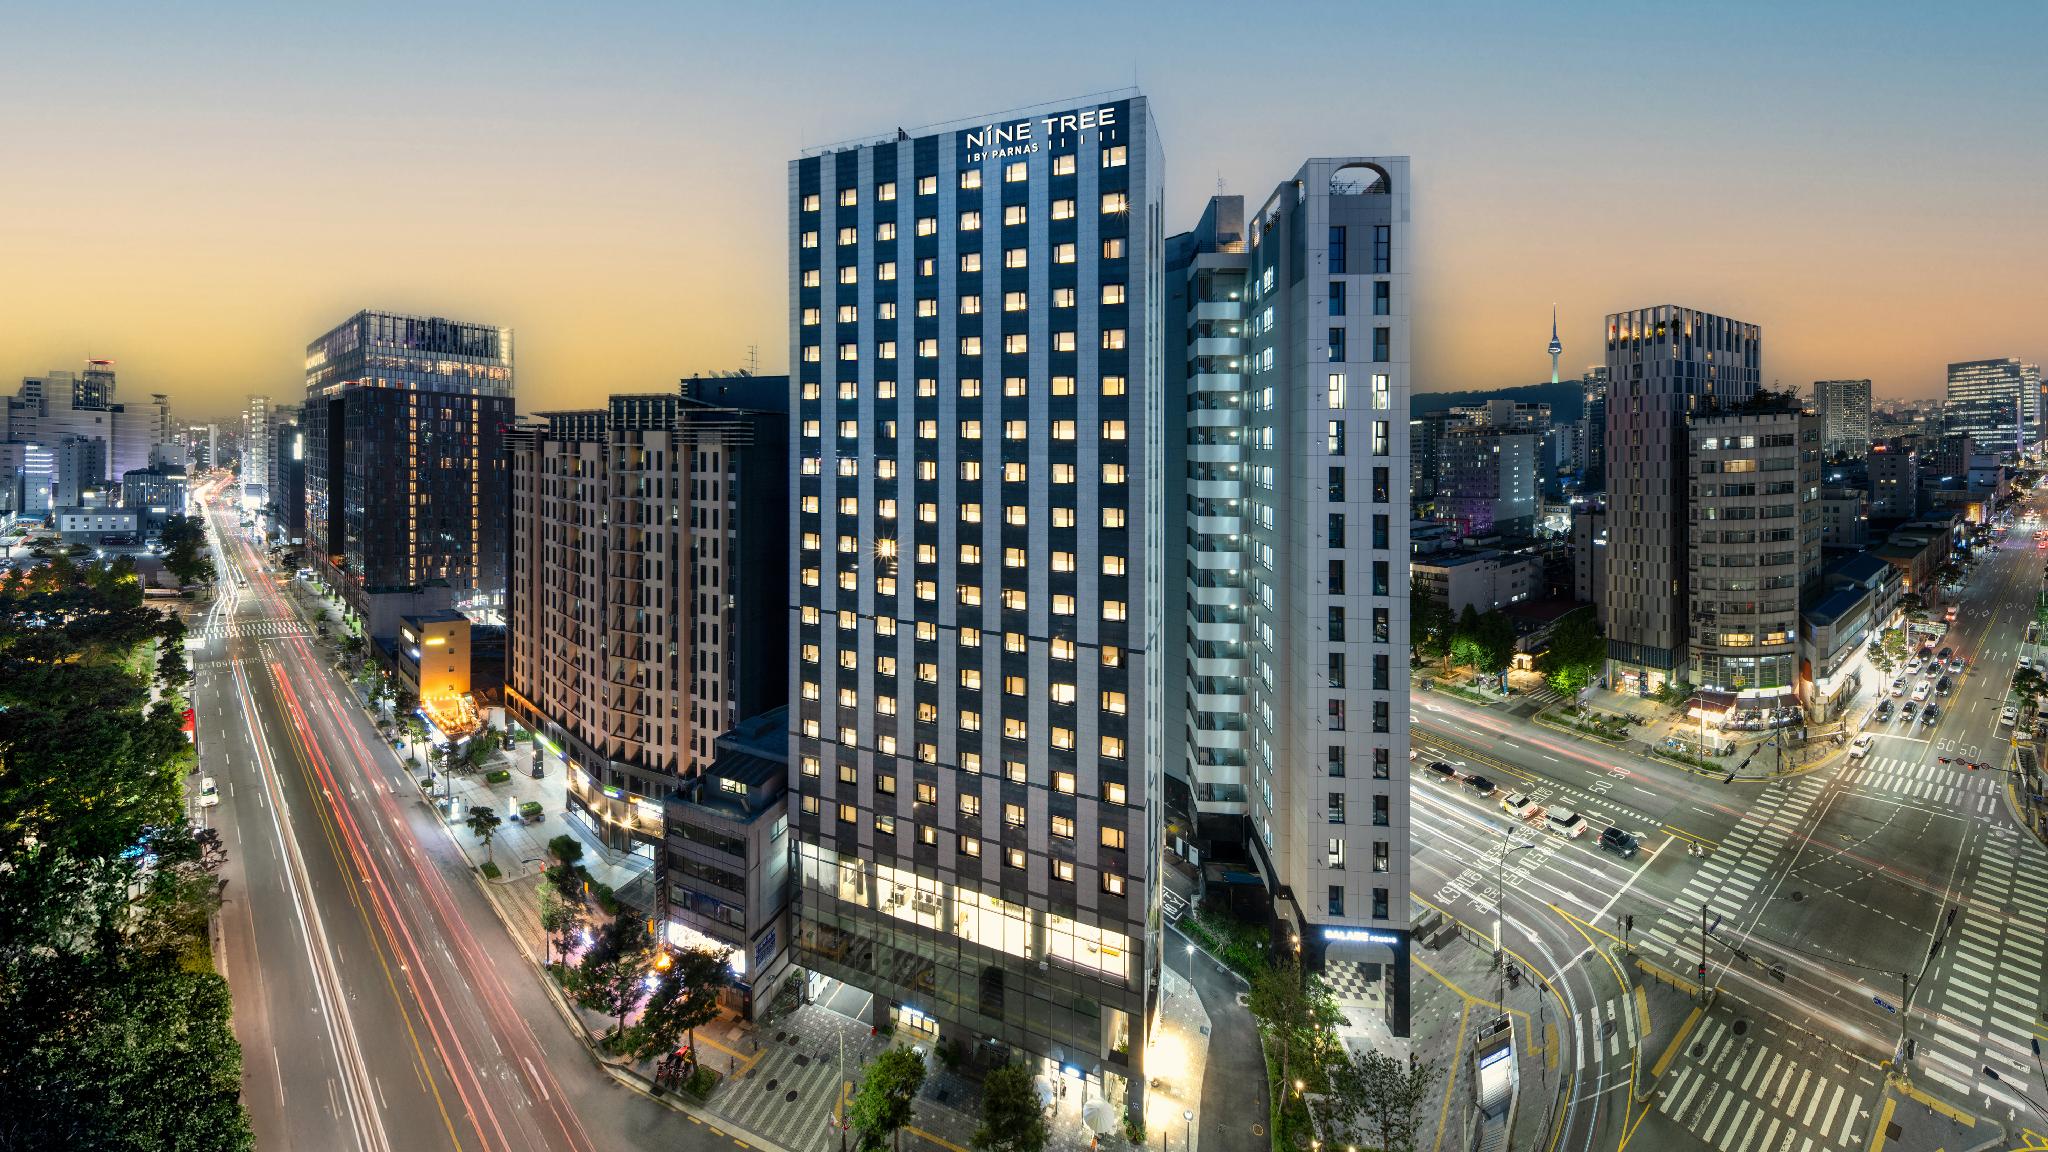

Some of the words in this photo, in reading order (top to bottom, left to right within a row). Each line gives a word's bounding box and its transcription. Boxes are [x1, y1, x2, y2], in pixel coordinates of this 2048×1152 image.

[1041, 107, 1116, 136] TREE
[991, 142, 1040, 160] PARNAS
[1937, 737, 1955, 752] 50
[1959, 743, 1978, 758] 50
[1607, 766, 1631, 780] 50
[1587, 780, 1613, 795] 50
